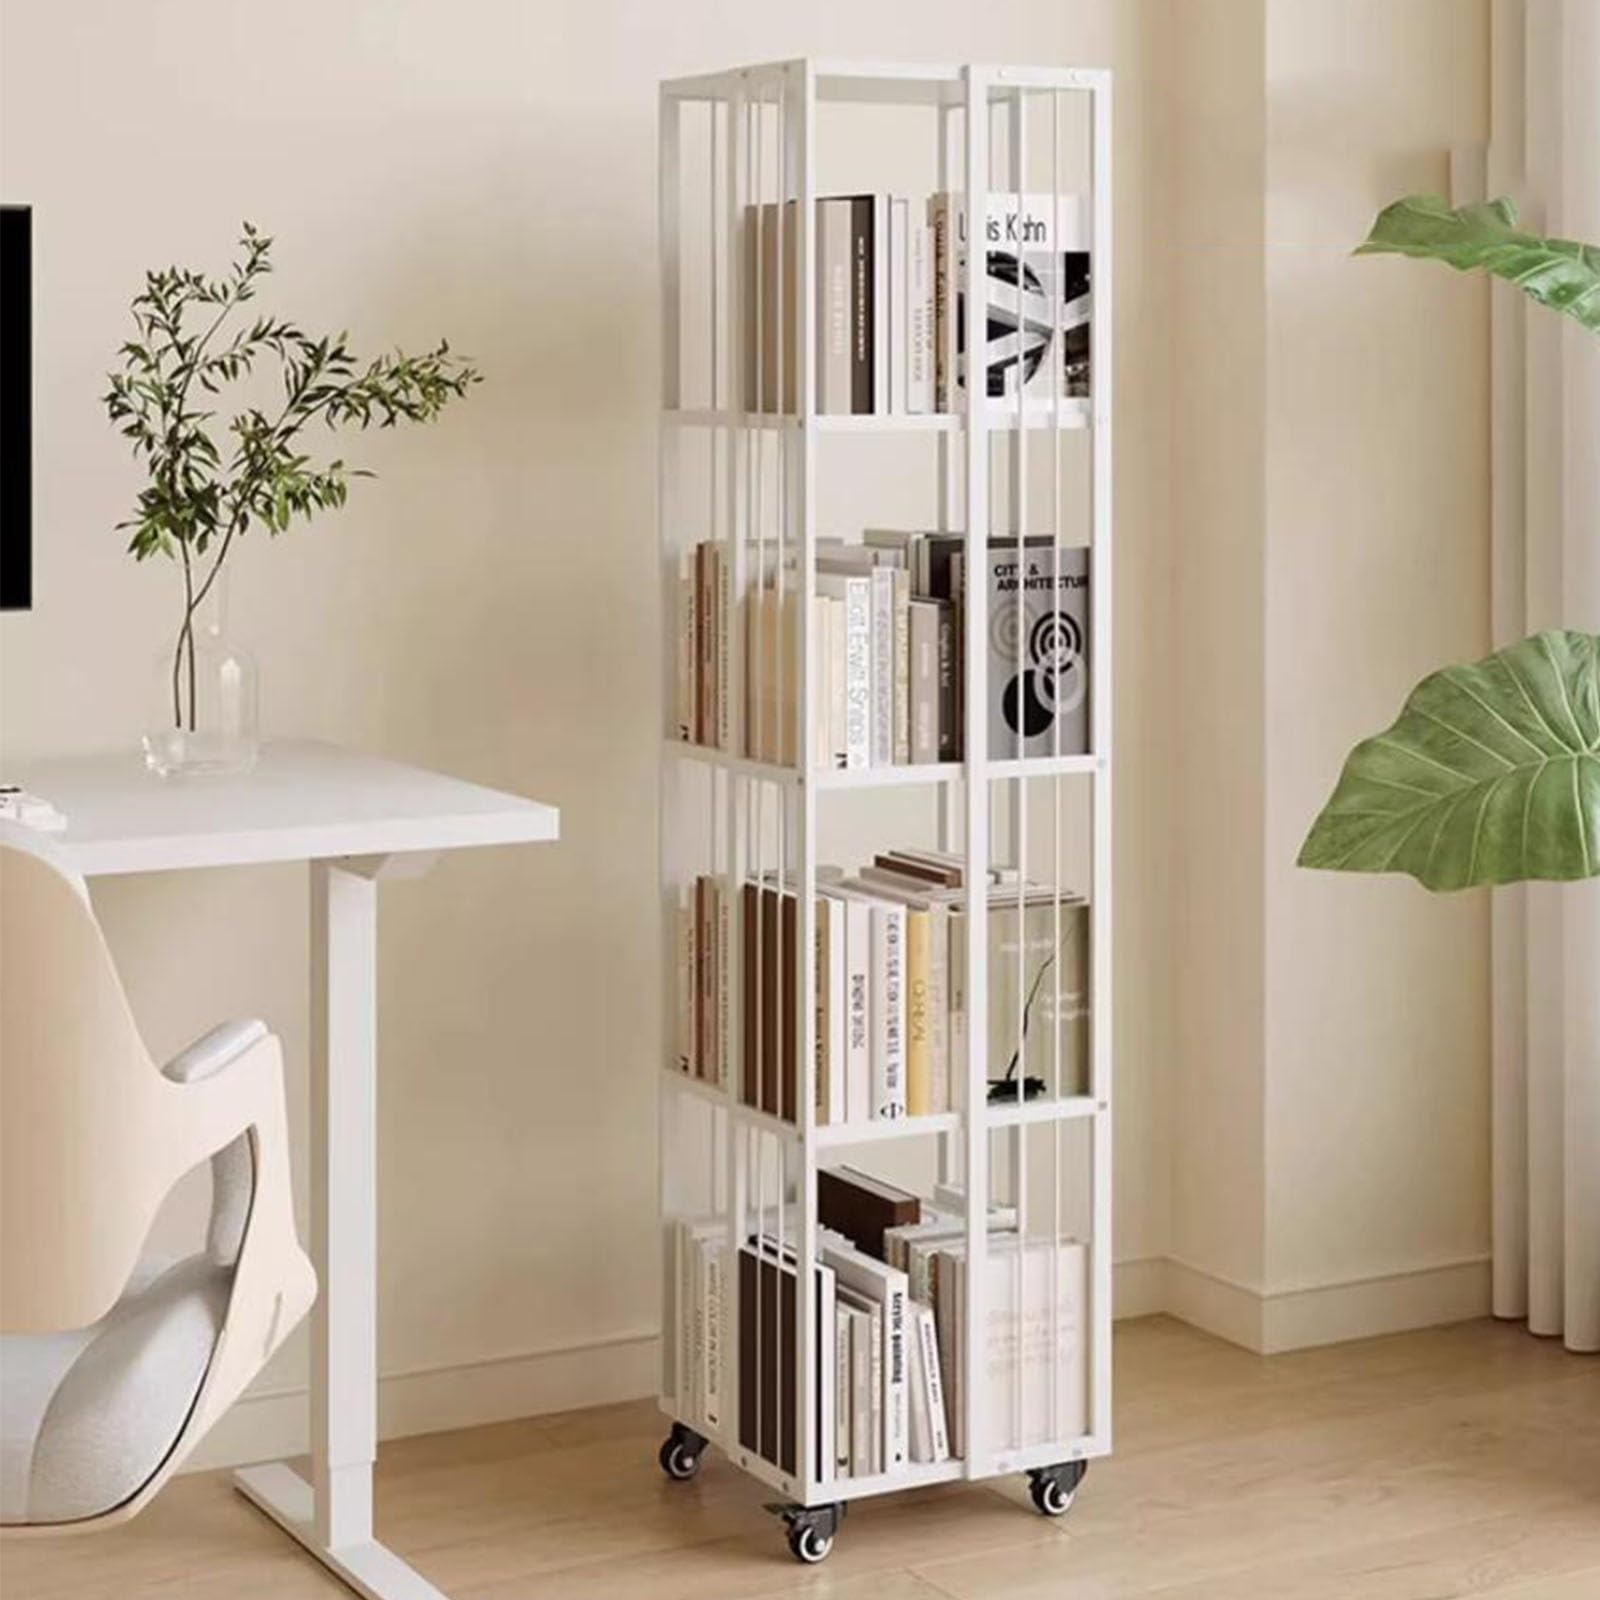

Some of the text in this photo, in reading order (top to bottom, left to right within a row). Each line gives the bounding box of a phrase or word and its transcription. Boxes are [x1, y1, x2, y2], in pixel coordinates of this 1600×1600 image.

[958, 212, 1001, 242] Lis
[993, 563, 1040, 577] CIT &
